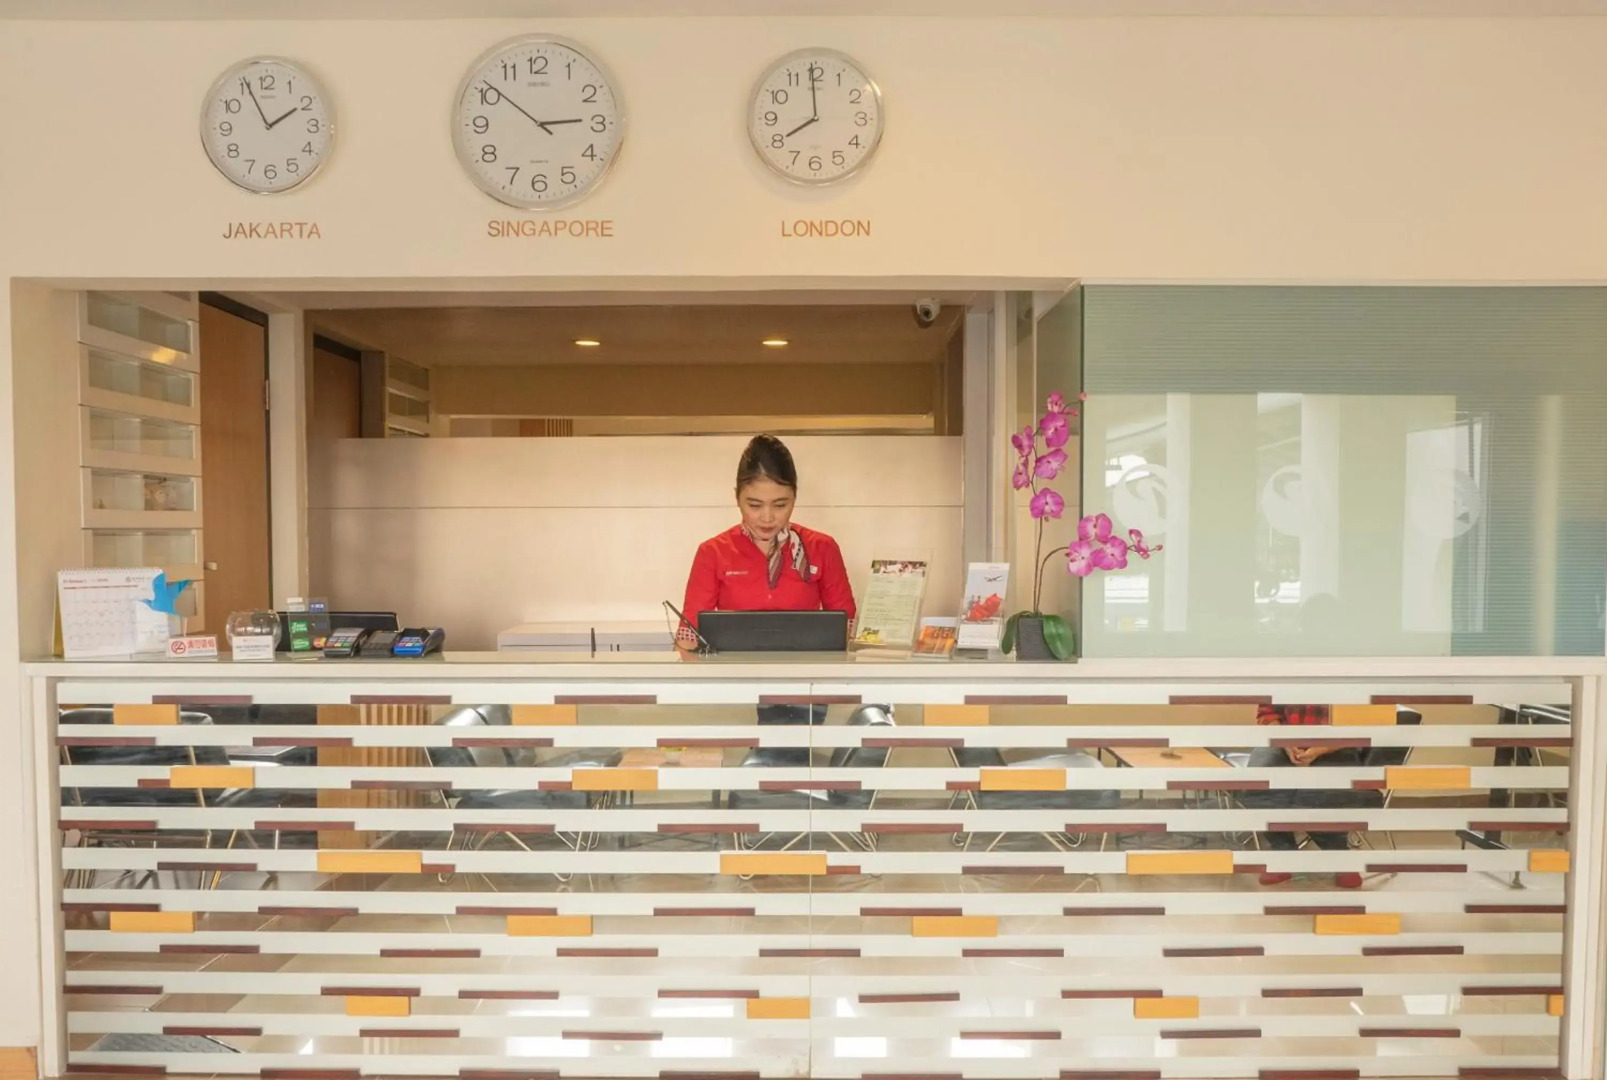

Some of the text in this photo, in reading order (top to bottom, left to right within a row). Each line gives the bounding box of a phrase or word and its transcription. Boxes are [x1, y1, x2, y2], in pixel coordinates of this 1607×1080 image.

[502, 63, 516, 81] 11
[527, 56, 548, 74] 12
[565, 63, 572, 80] 1
[259, 75, 275, 90] 12
[787, 72, 799, 86] 11
[835, 72, 842, 87] 1
[286, 80, 293, 94] 1
[582, 84, 597, 102] 2
[300, 96, 313, 111] 2
[479, 87, 501, 105] 10
[771, 89, 788, 104] 10
[849, 89, 861, 104] 2
[224, 99, 241, 113] 10
[307, 119, 319, 133] 3
[473, 115, 489, 134] 9
[591, 114, 606, 132] 3
[764, 111, 777, 126] 9
[855, 112, 867, 126] 3
[219, 121, 232, 136] 9
[302, 141, 313, 155] 4
[771, 134, 784, 149] 8
[849, 135, 860, 149] 4
[227, 143, 240, 158] 8
[482, 144, 497, 163] 8
[581, 144, 597, 161] 4
[832, 151, 844, 165] 5
[286, 158, 298, 173] 5
[789, 151, 800, 166] 7
[809, 156, 822, 171] 6
[244, 160, 255, 174] 7
[264, 165, 277, 179] 6
[505, 167, 520, 185] 7
[560, 166, 576, 184] 5
[531, 174, 548, 192] 6
[222, 222, 321, 239] JAKARTA
[487, 220, 614, 237] SINGAPORE
[781, 219, 871, 237] LONDON
